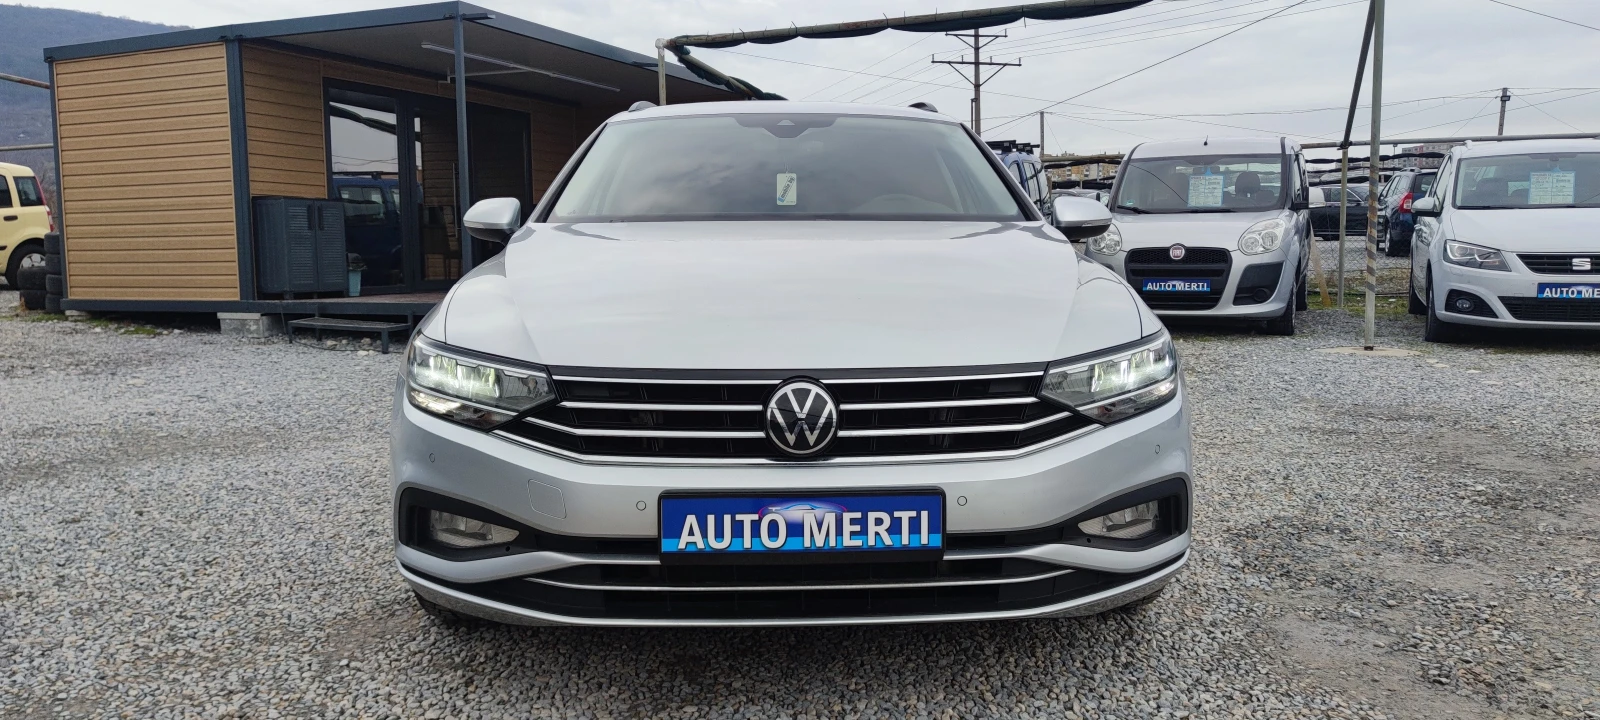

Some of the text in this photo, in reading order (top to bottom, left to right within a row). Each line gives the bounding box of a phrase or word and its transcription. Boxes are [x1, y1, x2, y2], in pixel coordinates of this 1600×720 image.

[1147, 283, 1207, 291] AUTO MERTI
[1543, 287, 1577, 298] AUTO
[677, 510, 929, 549] AUTO MERTI
